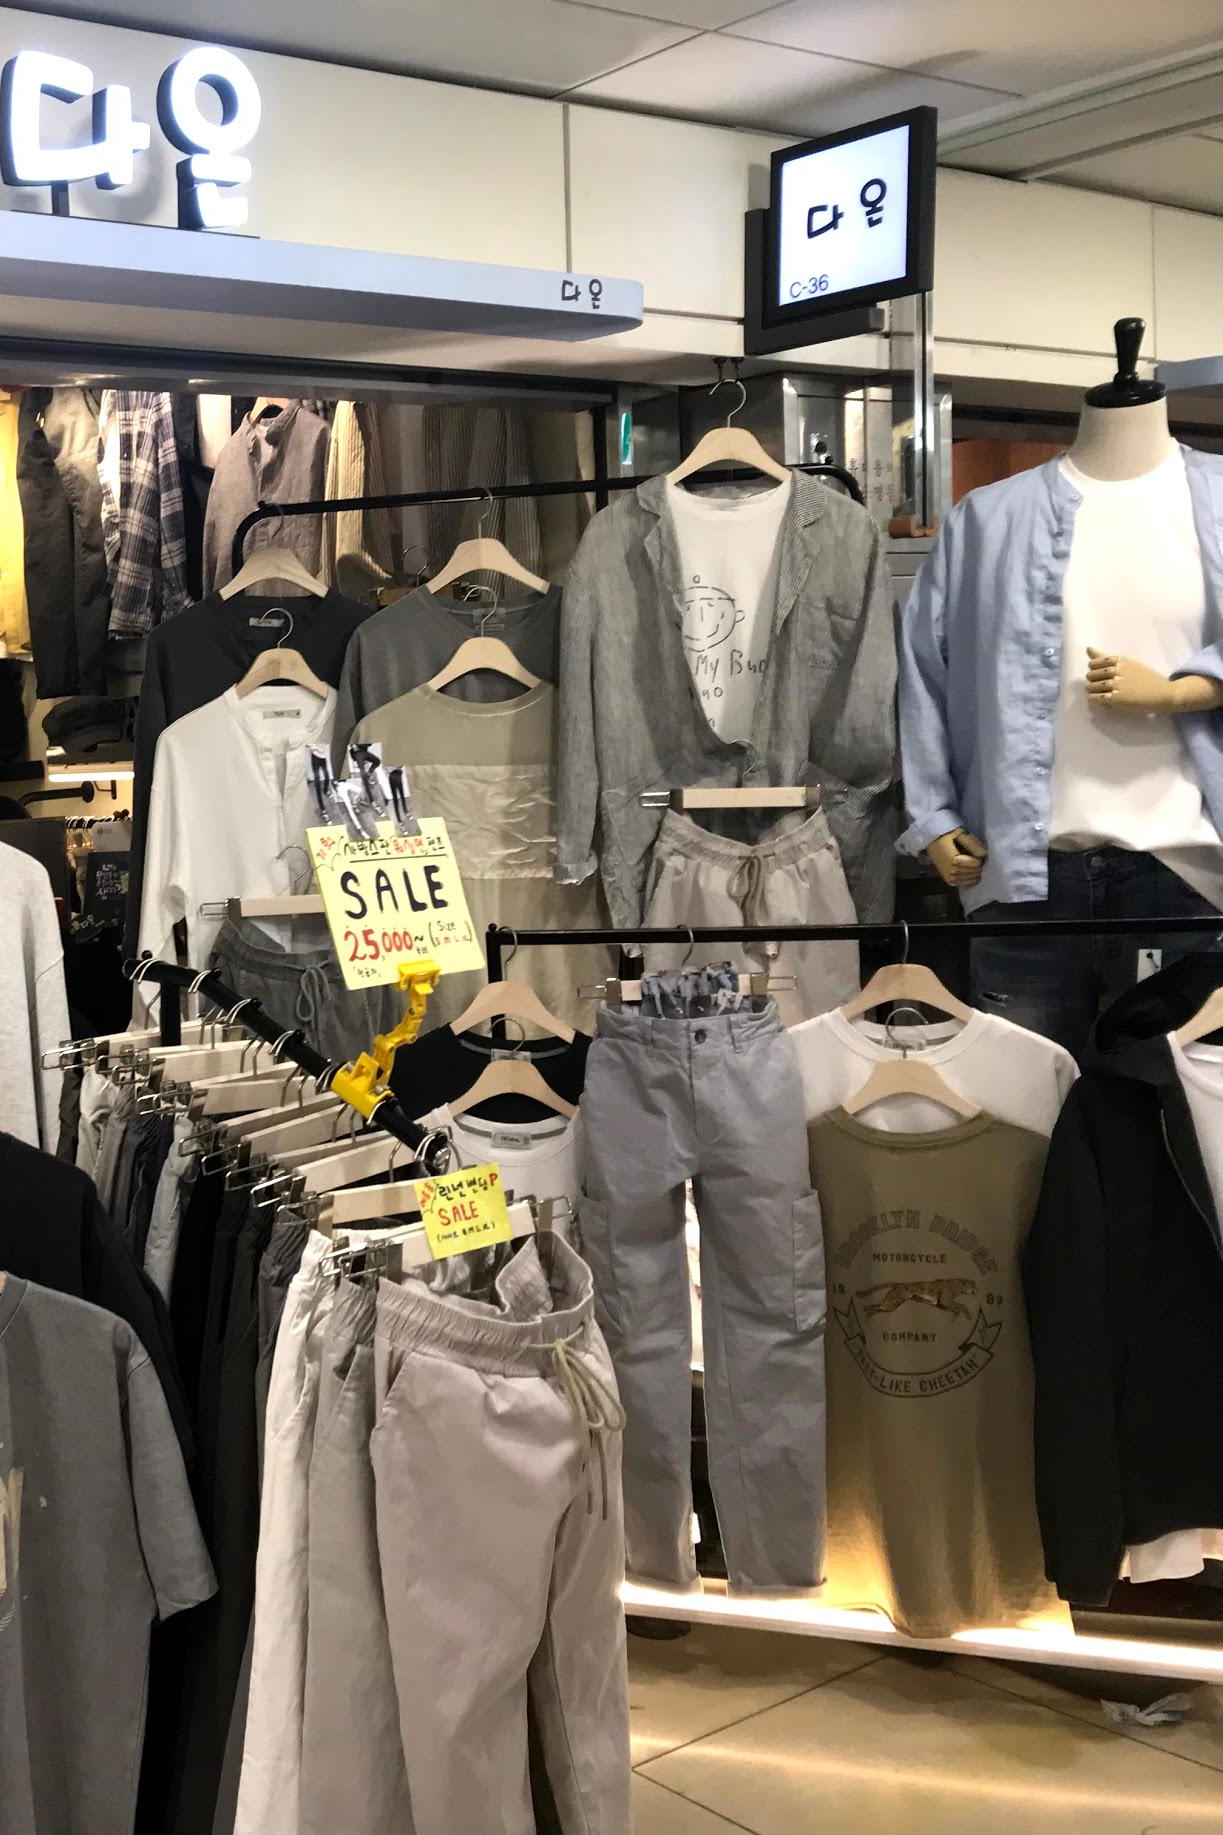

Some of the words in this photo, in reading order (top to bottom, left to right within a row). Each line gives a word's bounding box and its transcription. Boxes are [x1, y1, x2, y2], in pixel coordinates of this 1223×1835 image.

[806, 177, 888, 240] 다온
[561, 278, 603, 310] 다온
[789, 273, 830, 299] C-36
[340, 864, 449, 920] SALE
[437, 1200, 479, 1226] SALE
[872, 1252, 947, 1264] MOTORCYCLE
[882, 1332, 937, 1343] COMPANY
